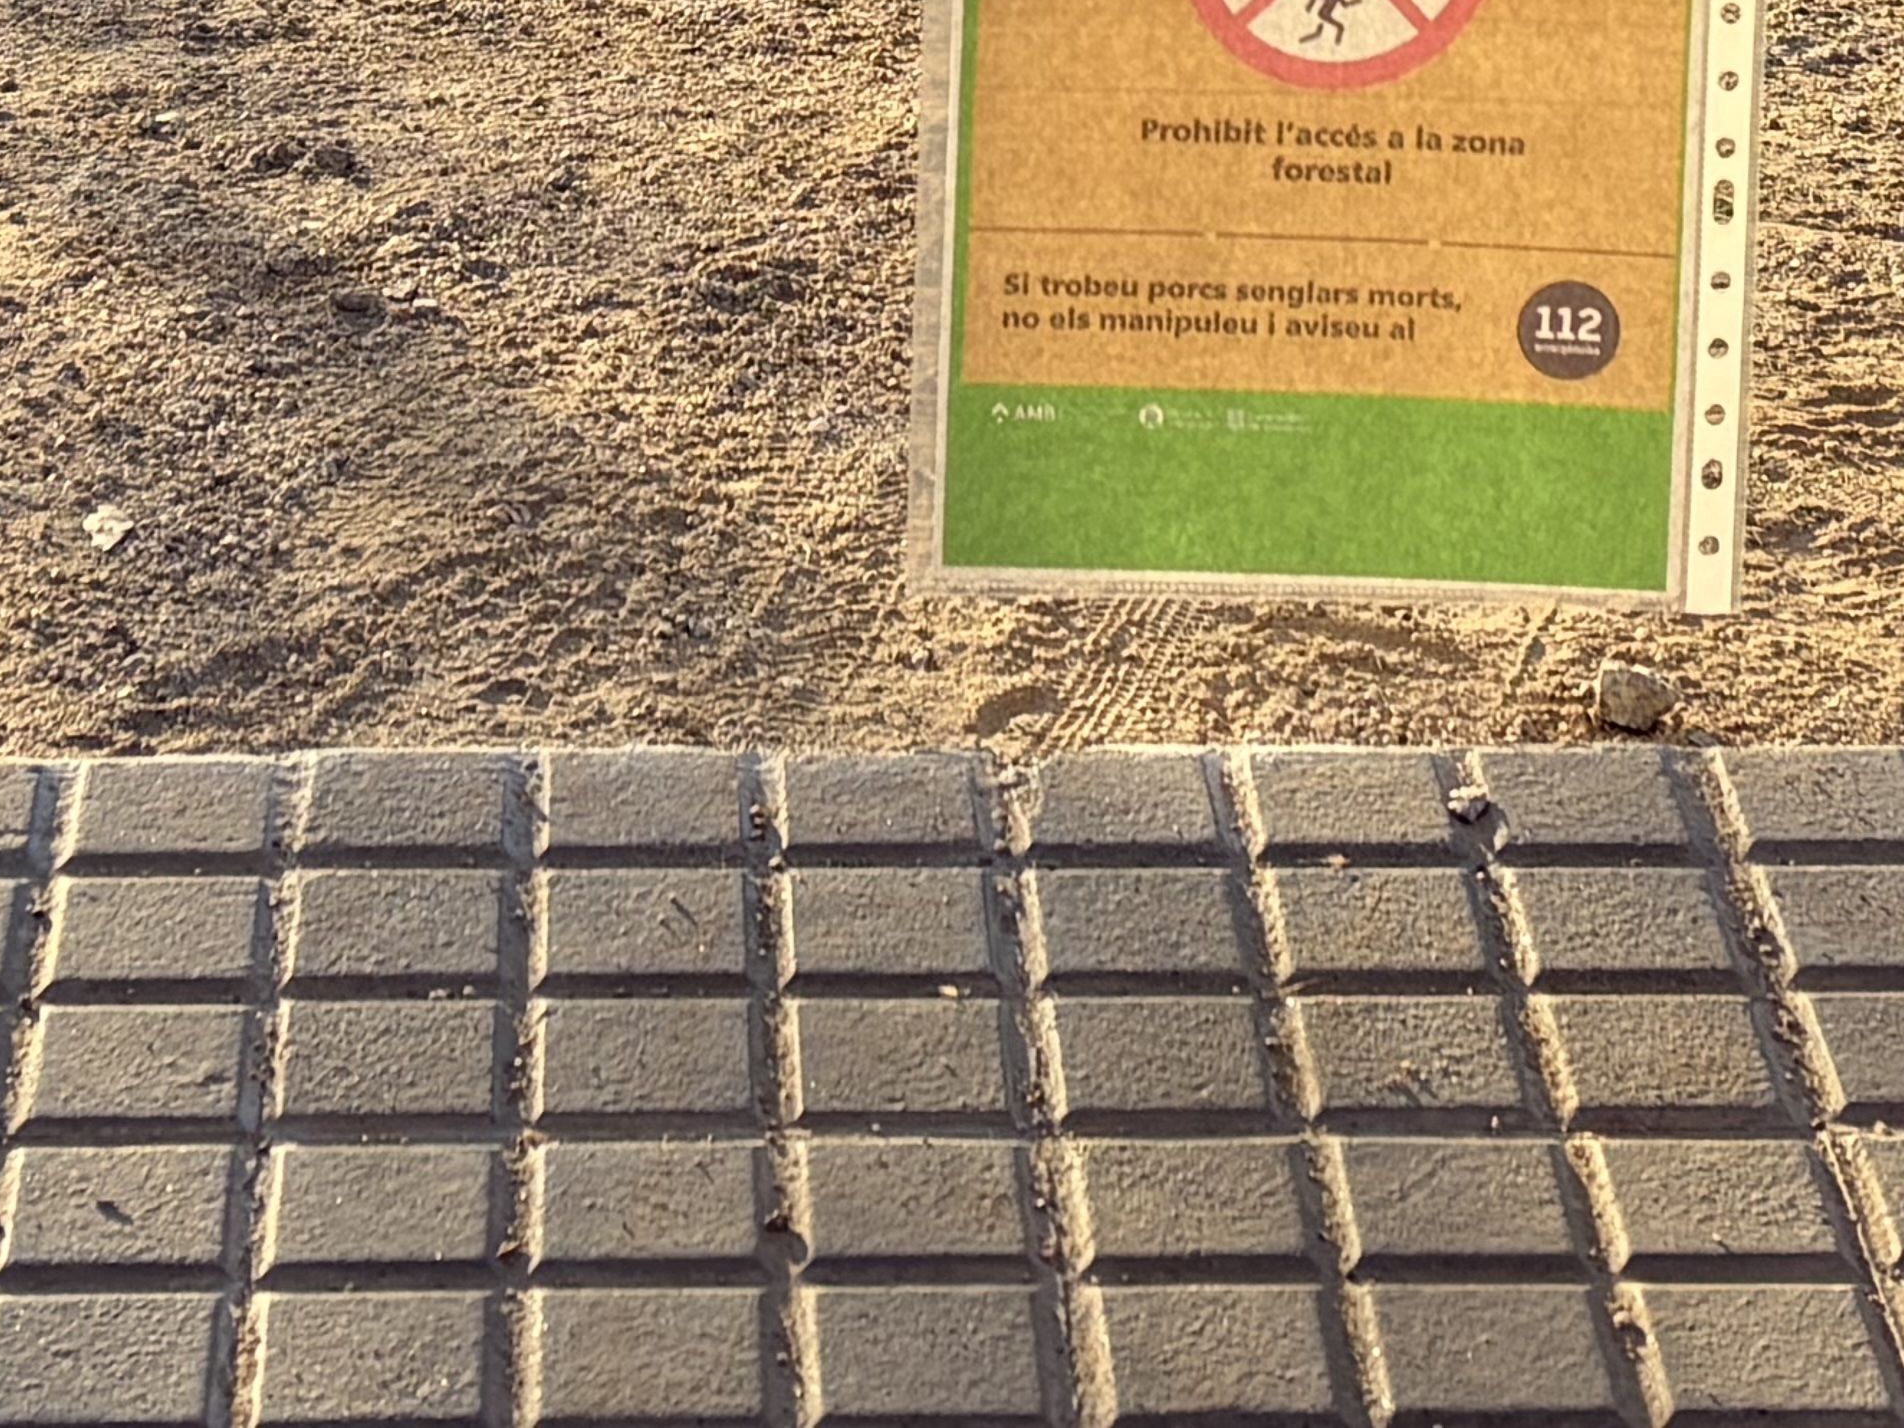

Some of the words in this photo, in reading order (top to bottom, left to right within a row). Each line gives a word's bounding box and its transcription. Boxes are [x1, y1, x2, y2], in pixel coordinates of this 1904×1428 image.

[1141, 117, 1266, 144] Prohibit
[1387, 128, 1404, 149] a
[1416, 125, 1442, 151] la
[1452, 133, 1525, 156] zona
[1272, 156, 1392, 184] forestal
[1003, 272, 1028, 296] Si
[1040, 274, 1138, 298] trobeu
[1147, 280, 1226, 303] porcs
[1236, 282, 1357, 308] senglars
[1368, 287, 1462, 312] morts,
[1001, 309, 1039, 330] no
[1049, 308, 1090, 330] els
[1099, 309, 1257, 338] manipuleu
[1268, 312, 1275, 337] i
[1285, 313, 1379, 339] aviseu
[1389, 317, 1415, 341] al
[1535, 305, 1602, 342] 112
[1014, 403, 1056, 421] AMB
